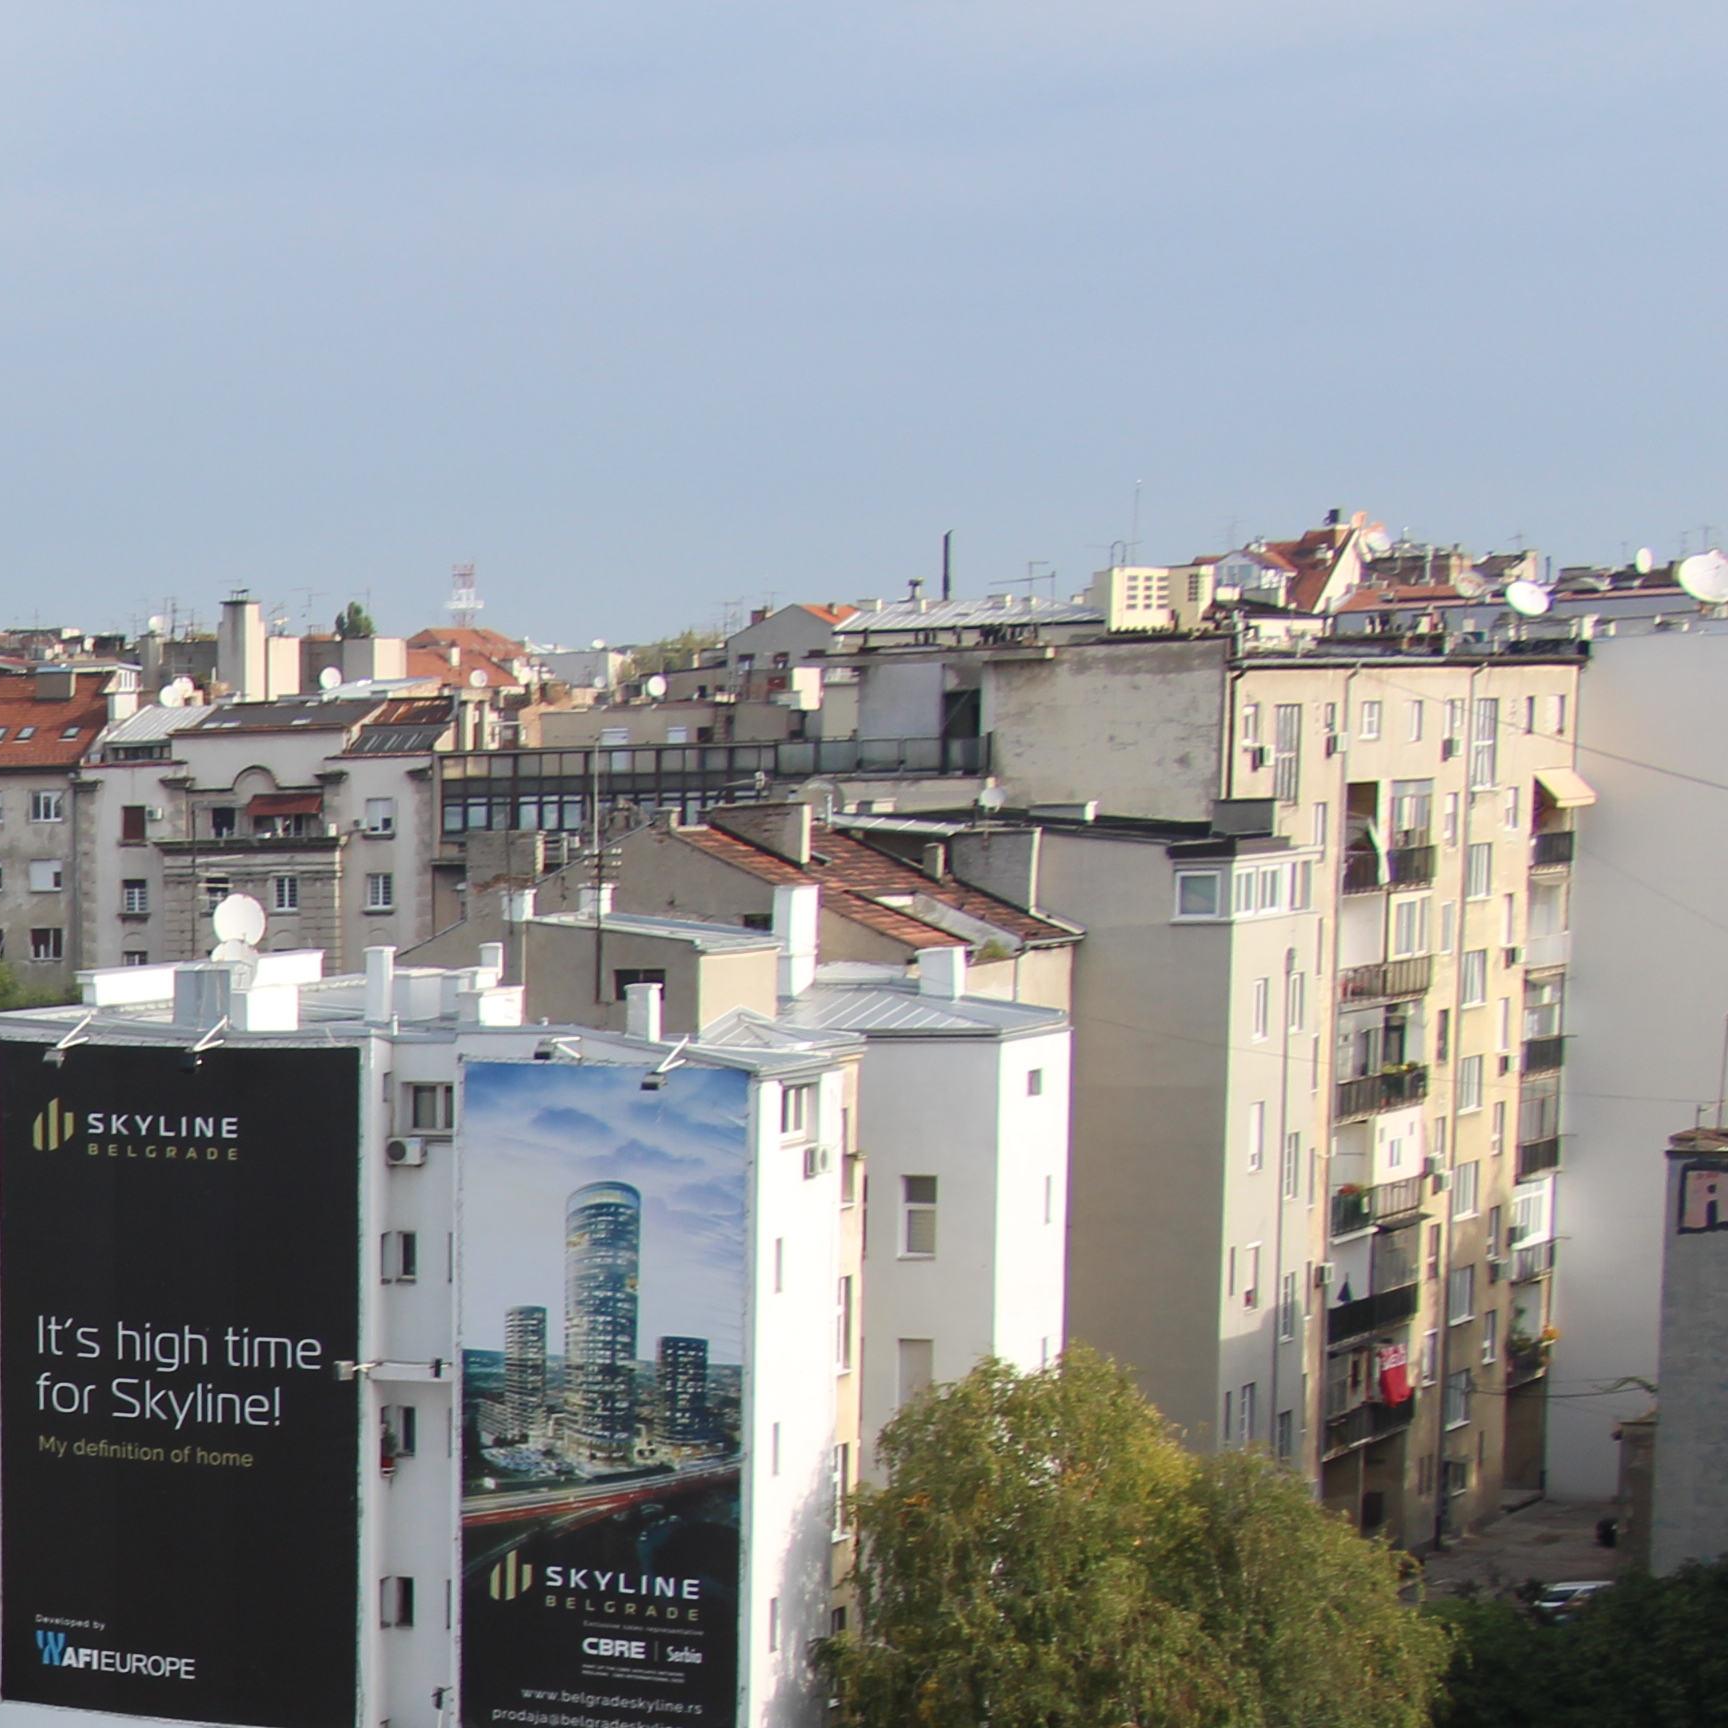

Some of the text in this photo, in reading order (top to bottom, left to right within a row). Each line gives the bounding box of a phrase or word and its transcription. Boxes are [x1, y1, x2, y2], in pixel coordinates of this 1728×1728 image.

[87, 1112, 238, 1139] SKYLINE
[87, 1143, 238, 1160] BELGRADE
[117, 1320, 208, 1372] high
[224, 1326, 322, 1370] time
[36, 1372, 281, 1430] for Skyline!
[38, 1435, 254, 1467] My definition of home
[545, 1566, 700, 1600] SKYLINE
[545, 1595, 699, 1621] BELGRADE
[35, 1614, 105, 1631] Developed by
[582, 1637, 646, 1659] CBRE
[520, 1688, 703, 1715] www.belgradeskyline.rs
